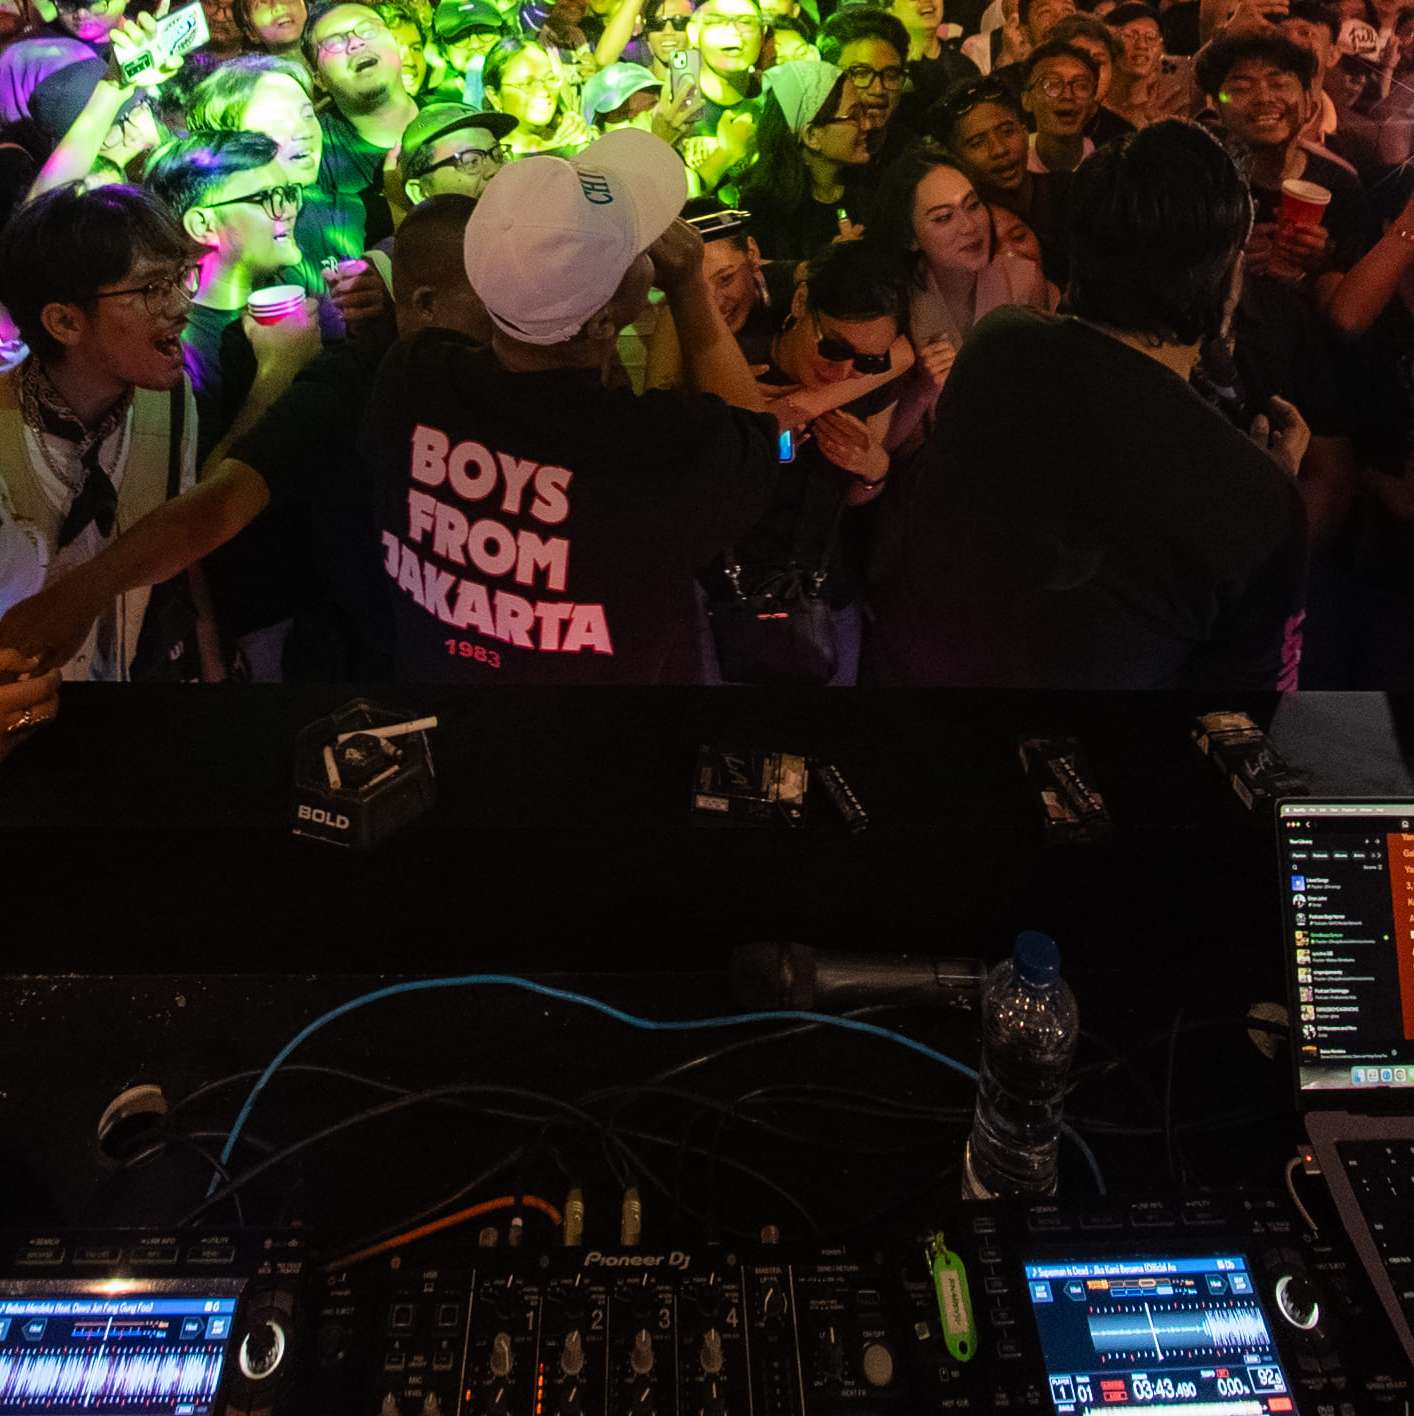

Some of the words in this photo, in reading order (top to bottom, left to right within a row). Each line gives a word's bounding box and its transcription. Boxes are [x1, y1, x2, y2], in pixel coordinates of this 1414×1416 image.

[411, 424, 573, 525] BOYS
[408, 488, 571, 592] FROM
[381, 530, 614, 656] JAKARTA
[444, 639, 501, 669] 1983
[298, 804, 350, 830] BOLD
[583, 1250, 666, 1267] Pioneer
[525, 1310, 535, 1331] 1
[590, 1309, 604, 1330] 2
[658, 1309, 671, 1329] 3
[725, 1307, 738, 1328] 4
[1059, 1384, 1067, 1400] 1
[1077, 1384, 1094, 1403] 01
